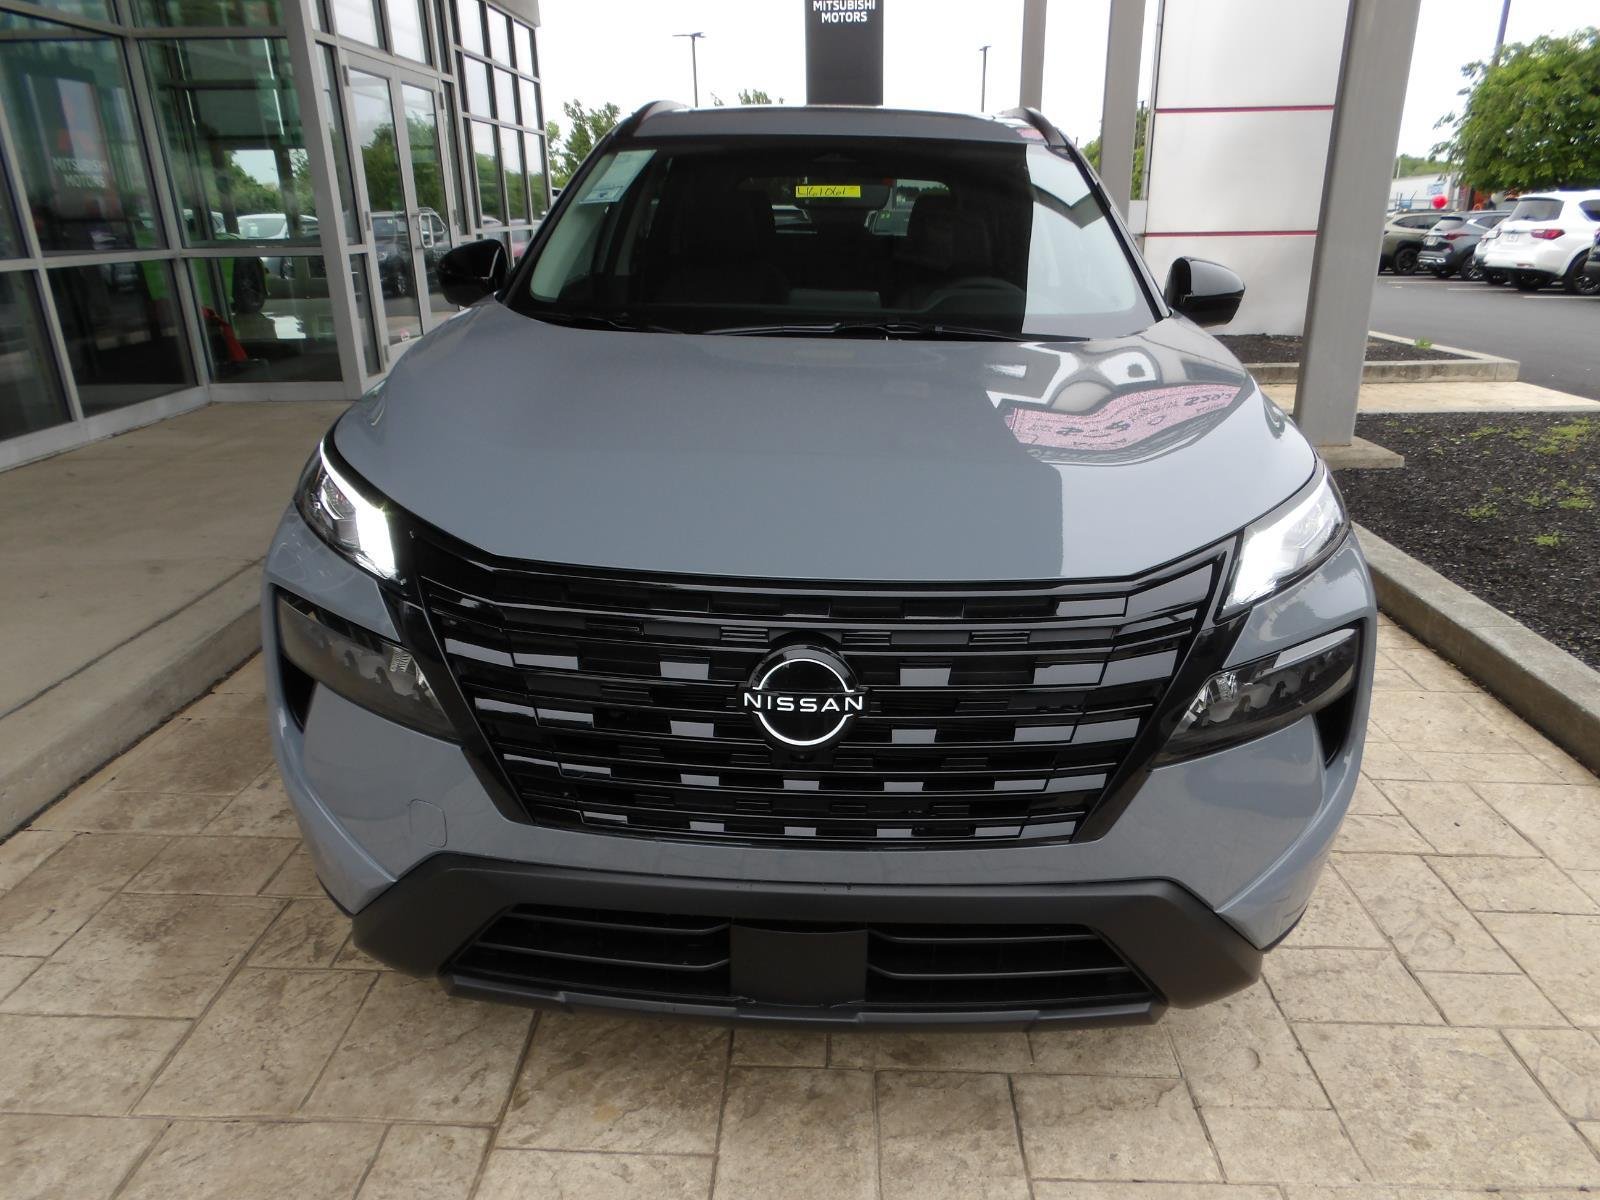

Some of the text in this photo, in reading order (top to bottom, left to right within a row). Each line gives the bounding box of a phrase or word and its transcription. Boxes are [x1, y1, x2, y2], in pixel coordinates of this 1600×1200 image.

[812, 0, 876, 11] MITSUBISHI
[821, 11, 868, 23] MOTORS
[743, 692, 863, 713] NISSAN
